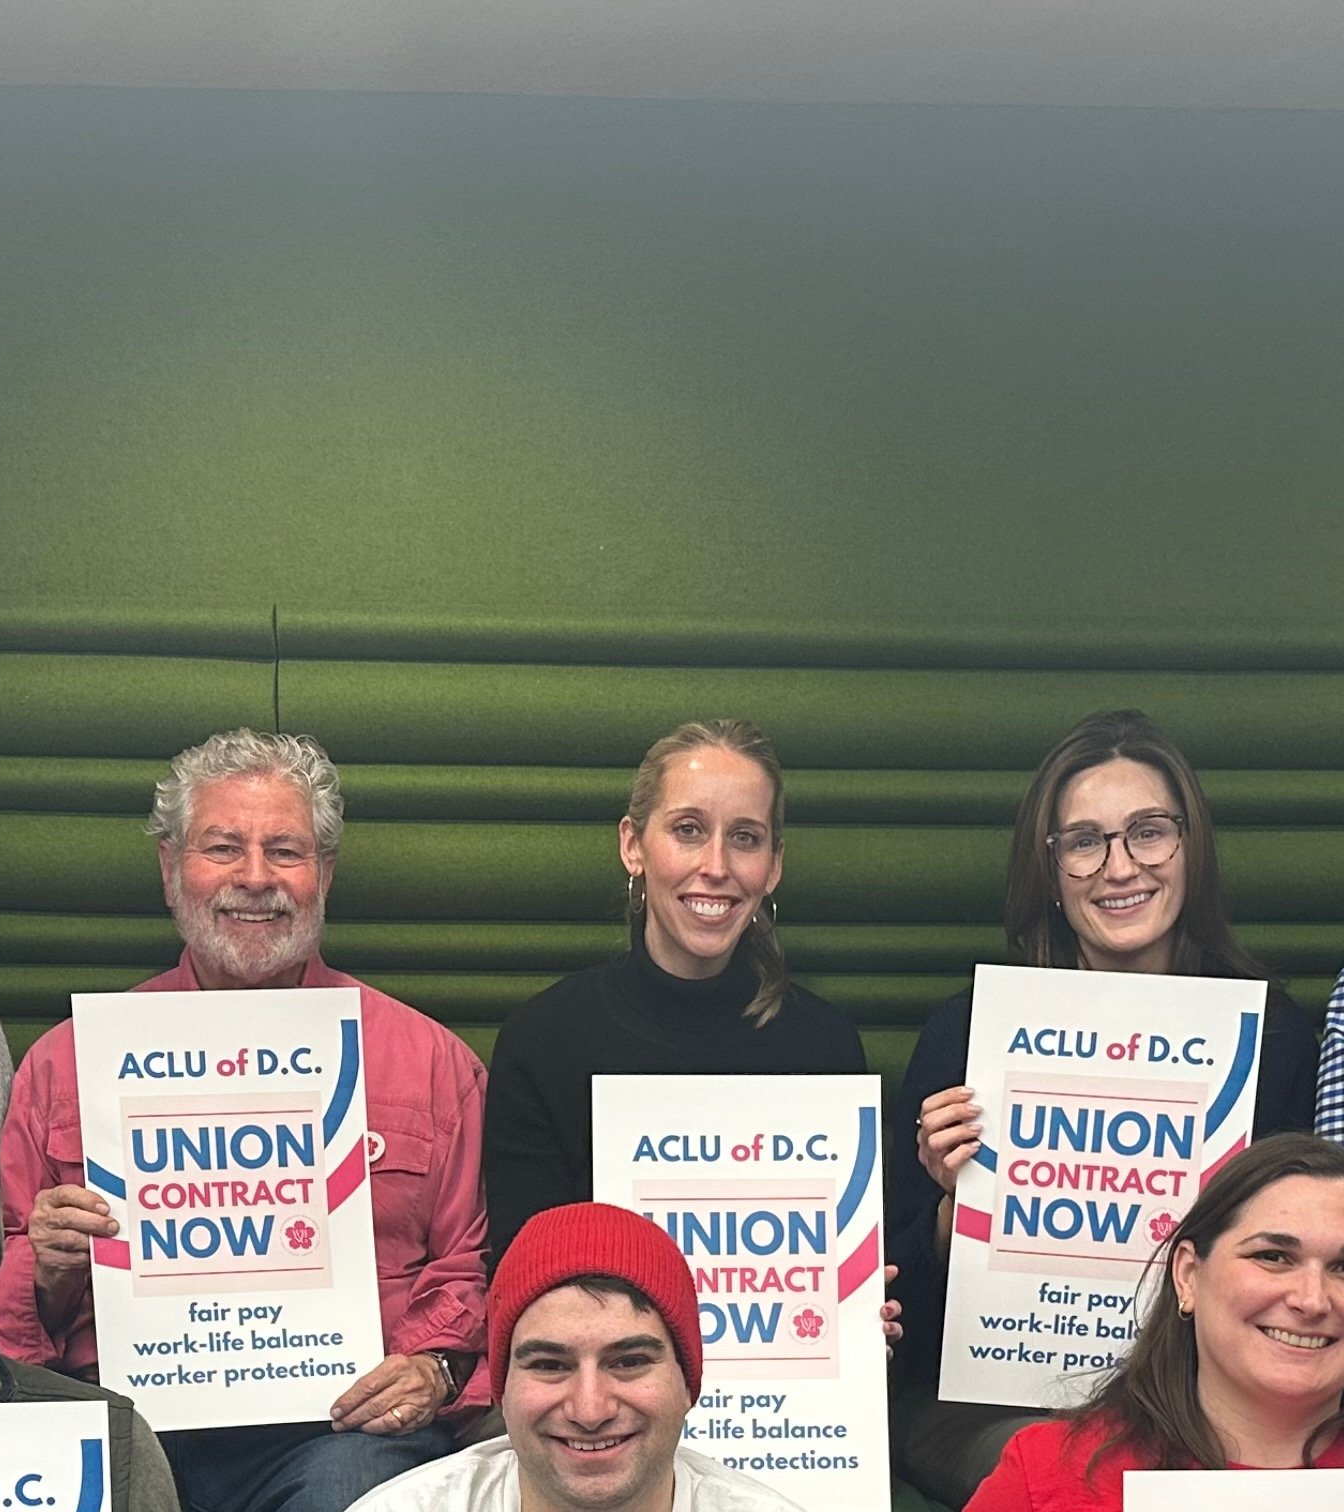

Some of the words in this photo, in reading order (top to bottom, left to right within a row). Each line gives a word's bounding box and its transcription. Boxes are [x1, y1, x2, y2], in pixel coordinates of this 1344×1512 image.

[1008, 1028, 1098, 1059] ACLU
[1107, 1033, 1142, 1061] of
[1148, 1036, 1215, 1067] D.C.
[118, 1051, 207, 1080] ACLU
[217, 1048, 249, 1077] of
[257, 1048, 323, 1076] D.C.
[1010, 1104, 1195, 1160] UNION
[132, 1124, 315, 1173] UNION
[633, 1135, 721, 1163] ACLU
[731, 1134, 765, 1162] of
[773, 1134, 838, 1162] D.C.
[1008, 1160, 1188, 1197] CONTRACT
[138, 1179, 314, 1211] CONTRACT
[1003, 1195, 1142, 1244] NOW
[141, 1215, 275, 1261] NOW
[696, 1266, 824, 1292] NTRACT
[1039, 1283, 1082, 1305] fair
[1087, 1294, 1133, 1314] pay
[189, 1302, 232, 1323] fair
[238, 1306, 283, 1327] pay
[698, 1302, 783, 1343] OW
[980, 1313, 1089, 1337] work-life
[133, 1331, 245, 1356] work-life
[251, 1329, 343, 1350] balance
[969, 1342, 1058, 1365] worker
[127, 1365, 218, 1388] worker
[225, 1358, 357, 1388] protections
[694, 1388, 733, 1408] air
[740, 1394, 787, 1413] pay
[682, 1418, 745, 1439] k-life
[752, 1418, 847, 1439] balance
[723, 1450, 859, 1470] protections
